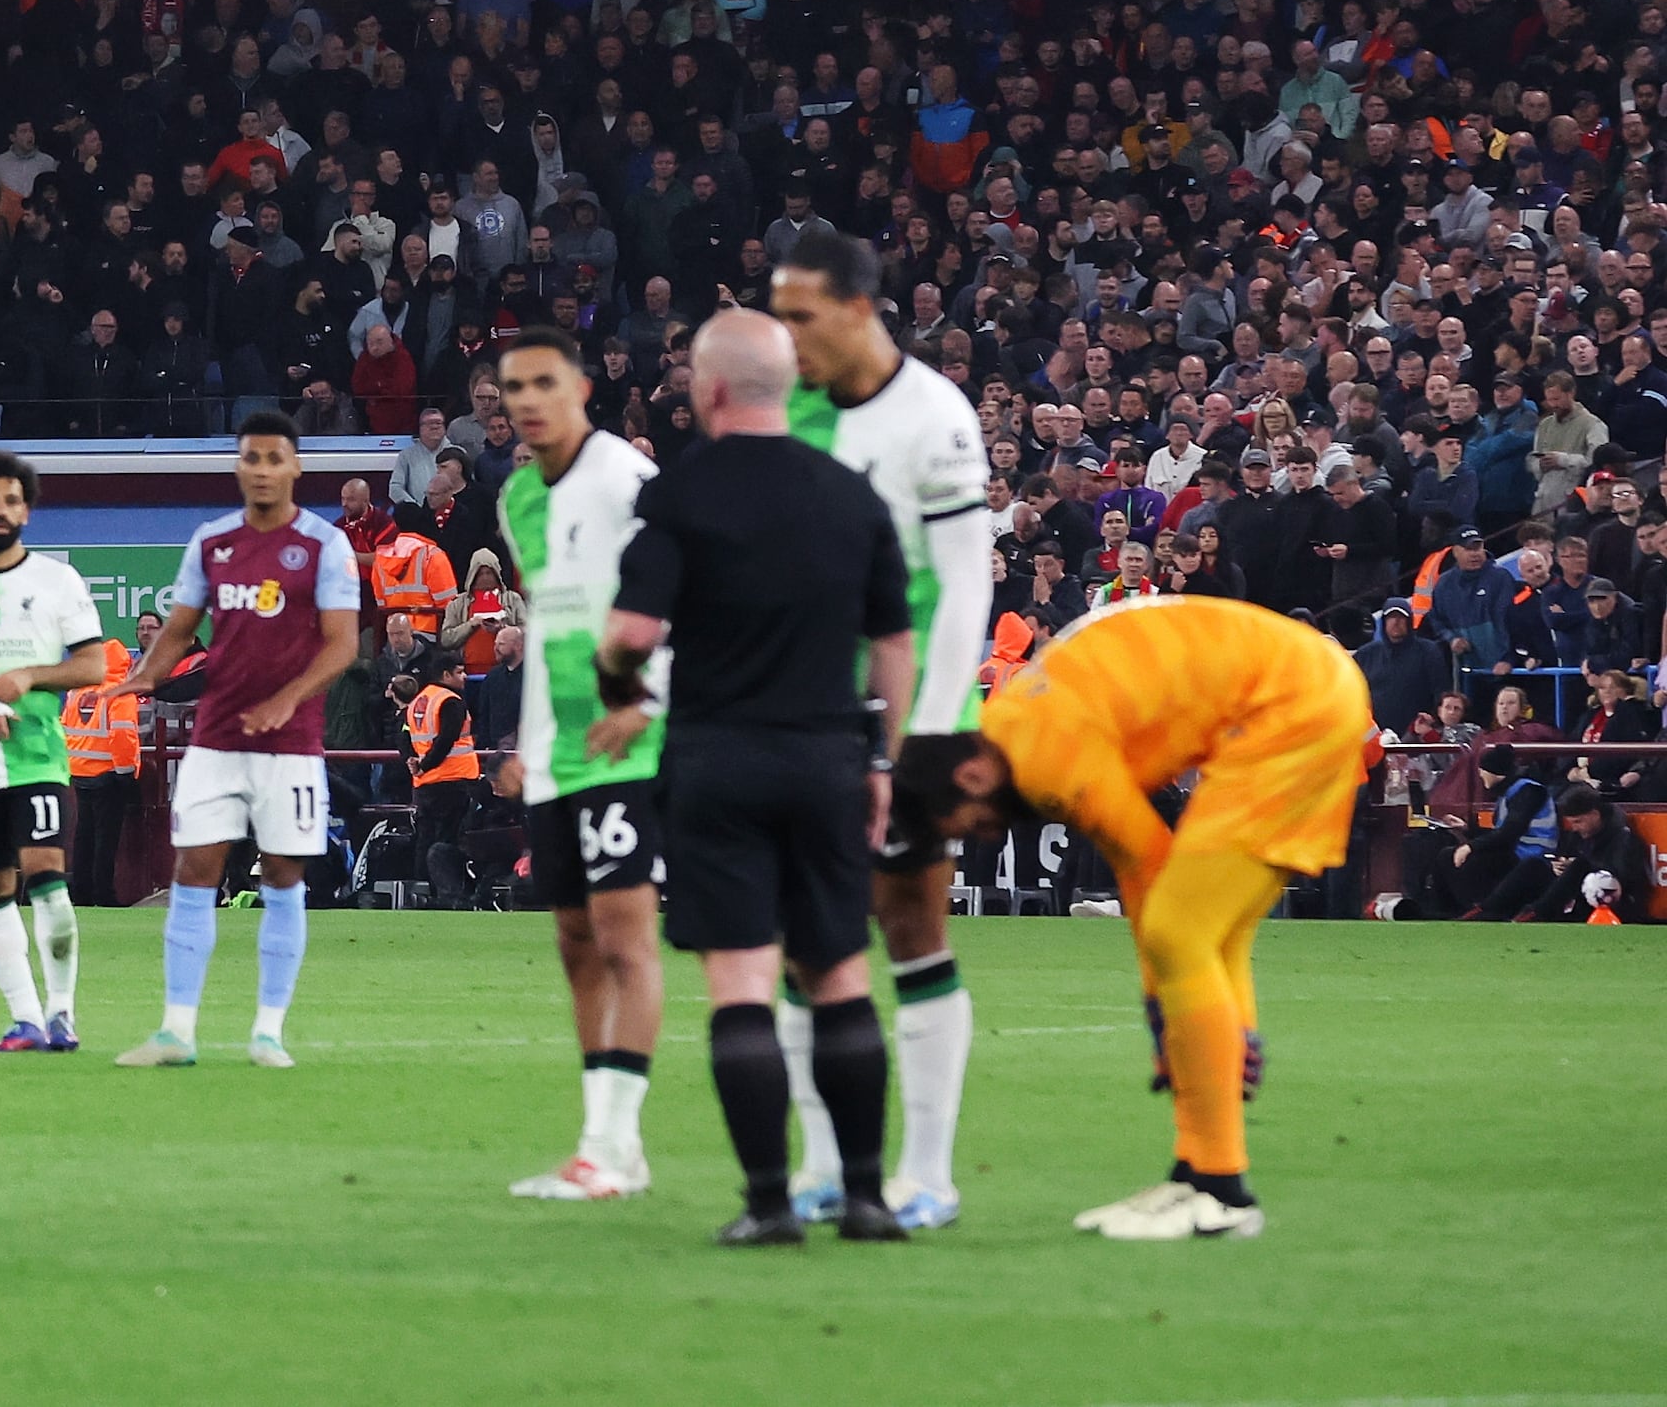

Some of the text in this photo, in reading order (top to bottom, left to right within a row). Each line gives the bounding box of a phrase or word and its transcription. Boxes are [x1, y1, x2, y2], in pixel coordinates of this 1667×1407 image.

[218, 578, 286, 618] BK8
[30, 794, 60, 831] 11
[292, 785, 316, 823] 11
[578, 801, 639, 863] 66
